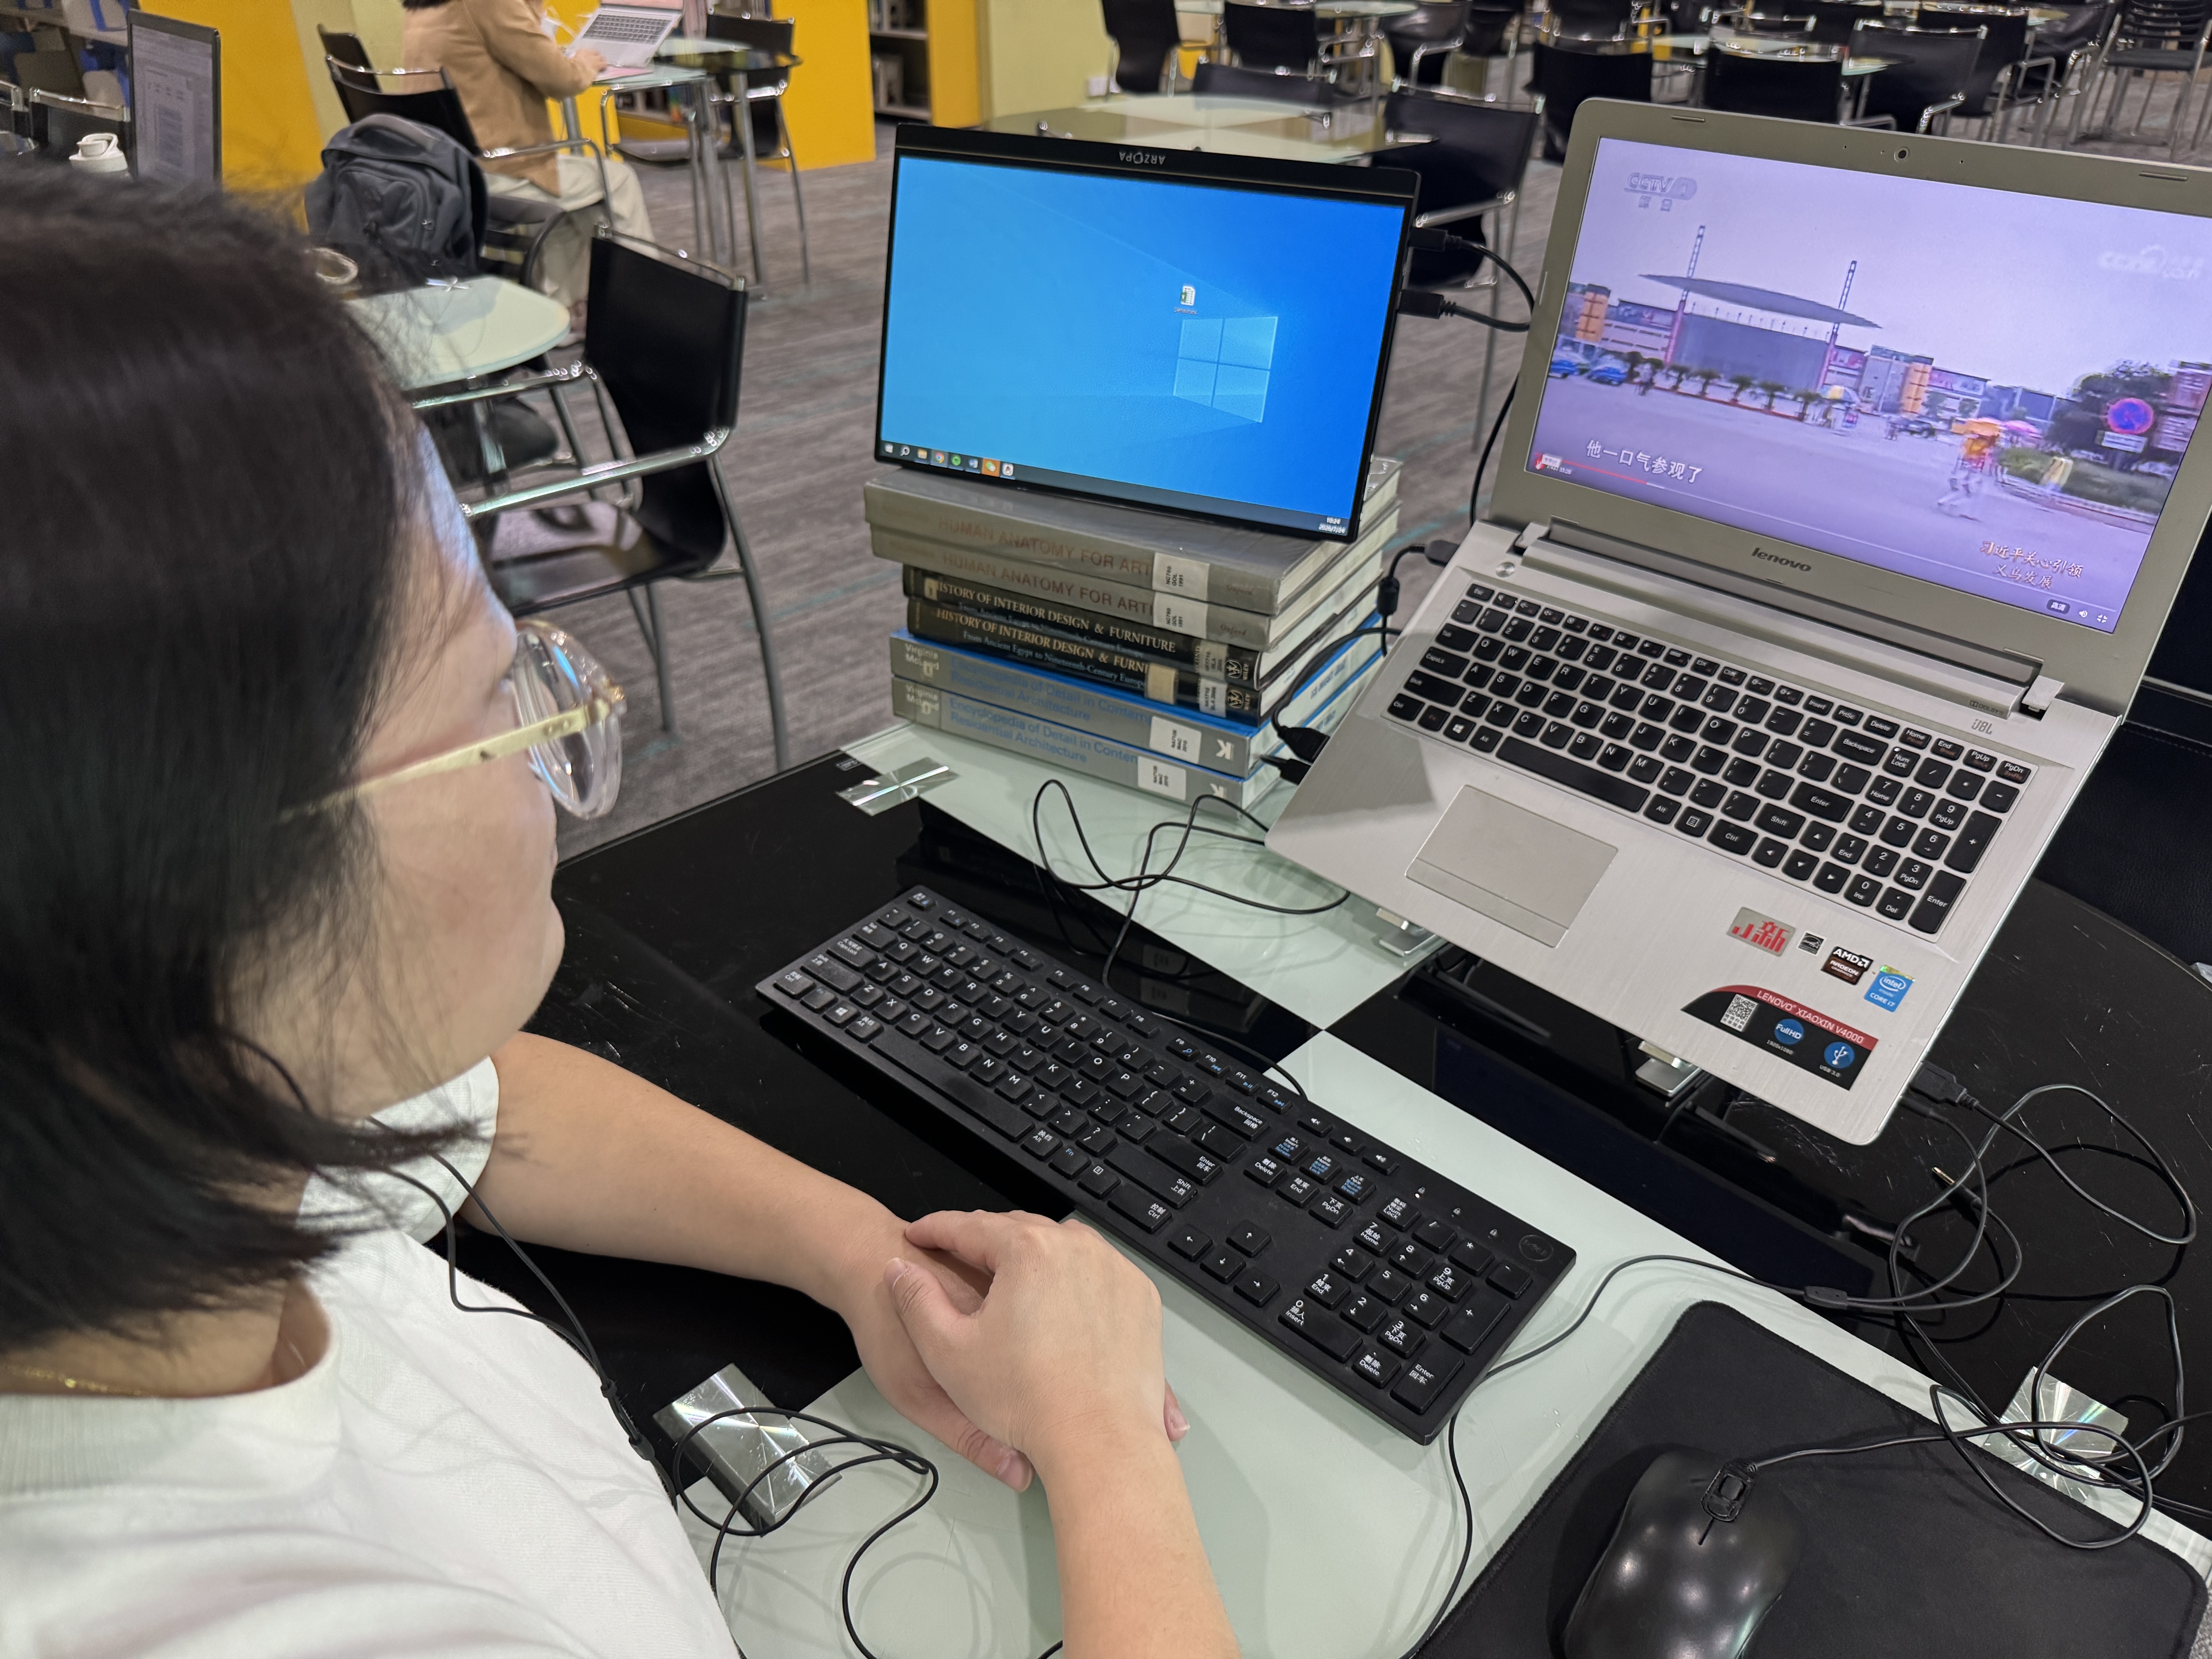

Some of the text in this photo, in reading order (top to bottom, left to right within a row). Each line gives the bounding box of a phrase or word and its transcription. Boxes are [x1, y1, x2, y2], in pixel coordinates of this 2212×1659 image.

[1119, 151, 1166, 165] ARZOPA
[1587, 440, 1702, 483] 他一口气参观了
[939, 520, 993, 540] HUMAN
[1000, 532, 1074, 559] ANATOMY
[1081, 549, 1114, 568] FOR
[1752, 548, 1811, 571] lenovo
[1980, 541, 2083, 578] 习近平关心引领
[943, 554, 996, 577] HUMAN
[1001, 569, 1074, 596] ANATOMY
[1080, 587, 1112, 606] FOR
[1993, 564, 2052, 590] 义乌发展
[977, 592, 991, 605] OF
[994, 596, 1045, 618] INTERIOR
[1047, 611, 1090, 630] DESIGN
[1094, 623, 1104, 635] &
[1109, 626, 1176, 653] FURNITURE
[937, 608, 981, 629] HISTORY
[982, 622, 998, 633] OF
[1000, 626, 1050, 648] INTERIOR
[1053, 640, 1095, 659] DESIGN
[1098, 653, 1108, 663] &
[964, 630, 982, 643] From
[985, 637, 1010, 650] Ancient
[1012, 644, 1033, 658] Egypt
[1034, 651, 1043, 659] to
[1508, 648, 1519, 657] W
[1648, 697, 1657, 706] U
[1809, 700, 1826, 710] Insert
[1580, 704, 1589, 713] G
[1838, 709, 1855, 720] PrtSc
[1870, 720, 1890, 731] Delete
[1971, 719, 1993, 735] JBL
[1028, 723, 1040, 734] of
[1043, 726, 1077, 744] Detail
[1080, 740, 1091, 750] in
[1576, 735, 1585, 744] B
[1906, 730, 1925, 740] Home
[1015, 732, 1087, 763] Architecture
[1668, 737, 1678, 746] K
[1843, 738, 1875, 754] Backspace
[1938, 740, 1952, 749] End
[1894, 754, 1910, 763] Num
[1971, 750, 1990, 762] PgUp
[1635, 758, 1648, 767] M
[1891, 759, 1907, 769] Lock
[2004, 763, 2023, 774] PgDn
[1810, 795, 1831, 807] Enter
[1870, 790, 1889, 801] Home
[1914, 792, 1923, 802] 8
[1947, 804, 1955, 813] 9
[1771, 815, 1790, 826] Shift
[1935, 814, 1954, 825] PgUp
[1725, 833, 1739, 842] Ctrl
[1838, 849, 1852, 858] End
[1900, 873, 1918, 885] PgDn
[1853, 892, 1864, 900] Ins
[1927, 895, 1948, 907] Enter
[1885, 905, 1898, 914] Del
[1833, 948, 1859, 964] AMD
[1829, 960, 1858, 976] RADEON
[1883, 977, 1902, 989] intel
[1870, 992, 1886, 1004] CORE
[1797, 1008, 1834, 1030] XIAOXIN
[1836, 1025, 1864, 1044] V4000
[1205, 1054, 1216, 1063] F10
[1048, 1064, 1059, 1072] K
[1009, 1075, 1020, 1084] M
[1267, 1089, 1278, 1097] F12
[1234, 1106, 1263, 1124] Backspace
[1199, 1156, 1215, 1167] Enter
[1255, 1161, 1273, 1175] Delete
[1176, 1178, 1191, 1189] Shift
[1290, 1183, 1303, 1194] End
[1322, 1201, 1339, 1214] PgDn
[1330, 1197, 1344, 1209] 下页
[1148, 1210, 1160, 1219] Ctrl
[1383, 1208, 1398, 1219] Lock
[1387, 1205, 1401, 1216] Num
[1360, 1231, 1379, 1245] Home
[1406, 1245, 1415, 1253] 8
[1382, 1270, 1391, 1278] 5
[1311, 1283, 1324, 1295] End
[1433, 1276, 1450, 1290] PgUp
[1285, 1310, 1304, 1326] Insert
[1384, 1331, 1403, 1345] PgDn
[1391, 1325, 1407, 1340] 下页
[1359, 1359, 1380, 1375] Delete
[1415, 1364, 1434, 1378] Enter
[1409, 1370, 1428, 1385] 回车
